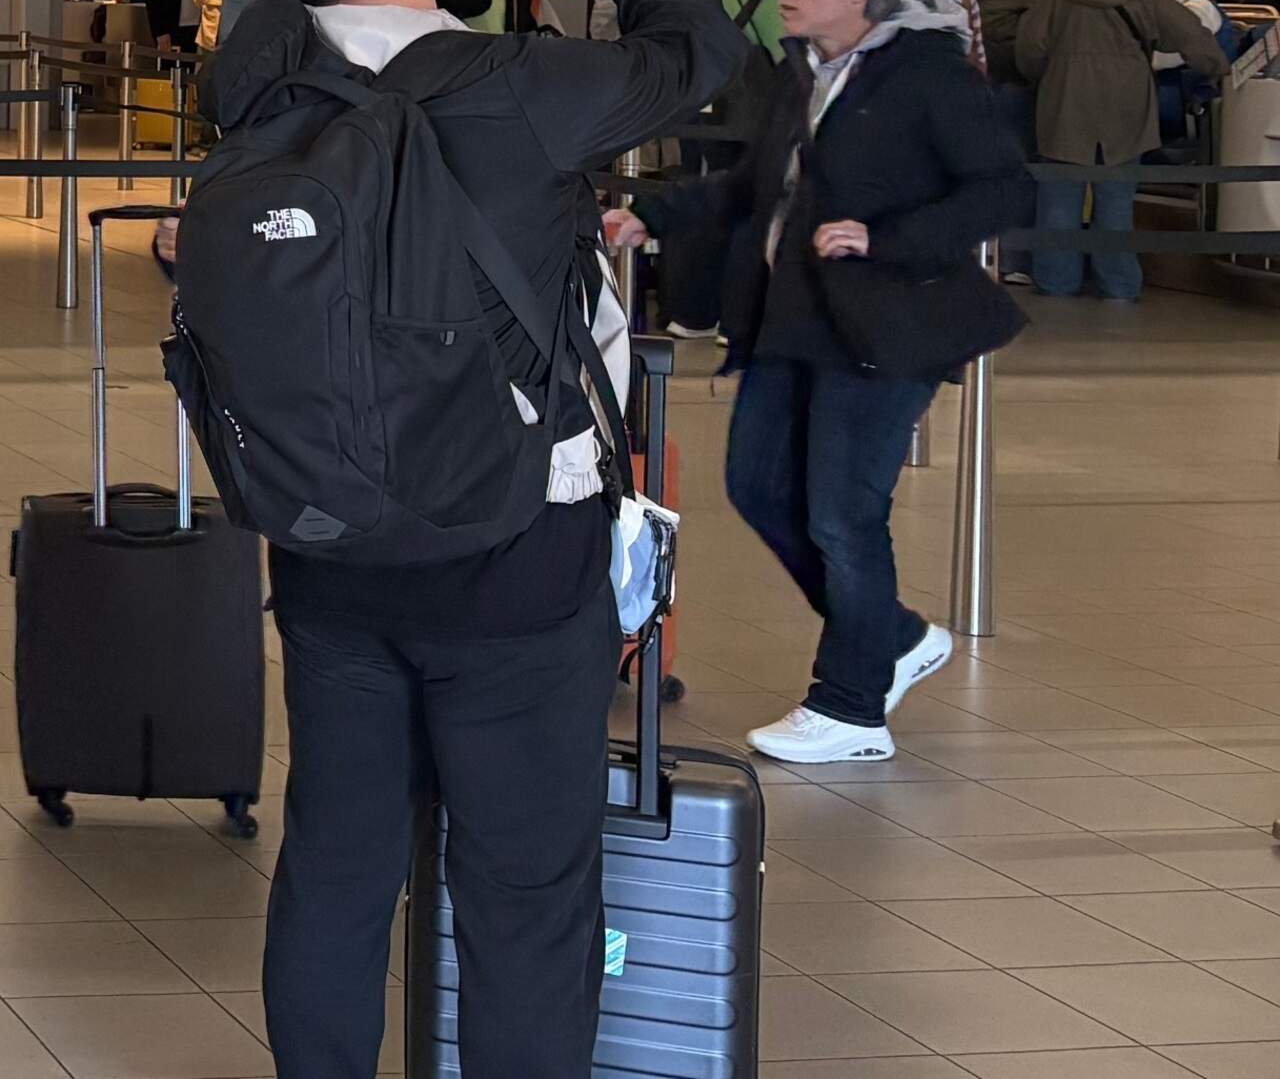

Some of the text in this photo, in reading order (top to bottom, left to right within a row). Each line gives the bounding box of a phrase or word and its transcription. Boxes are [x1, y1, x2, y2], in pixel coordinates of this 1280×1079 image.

[267, 208, 291, 221] THE
[252, 220, 292, 234] NORTH
[265, 229, 294, 242] FACE
